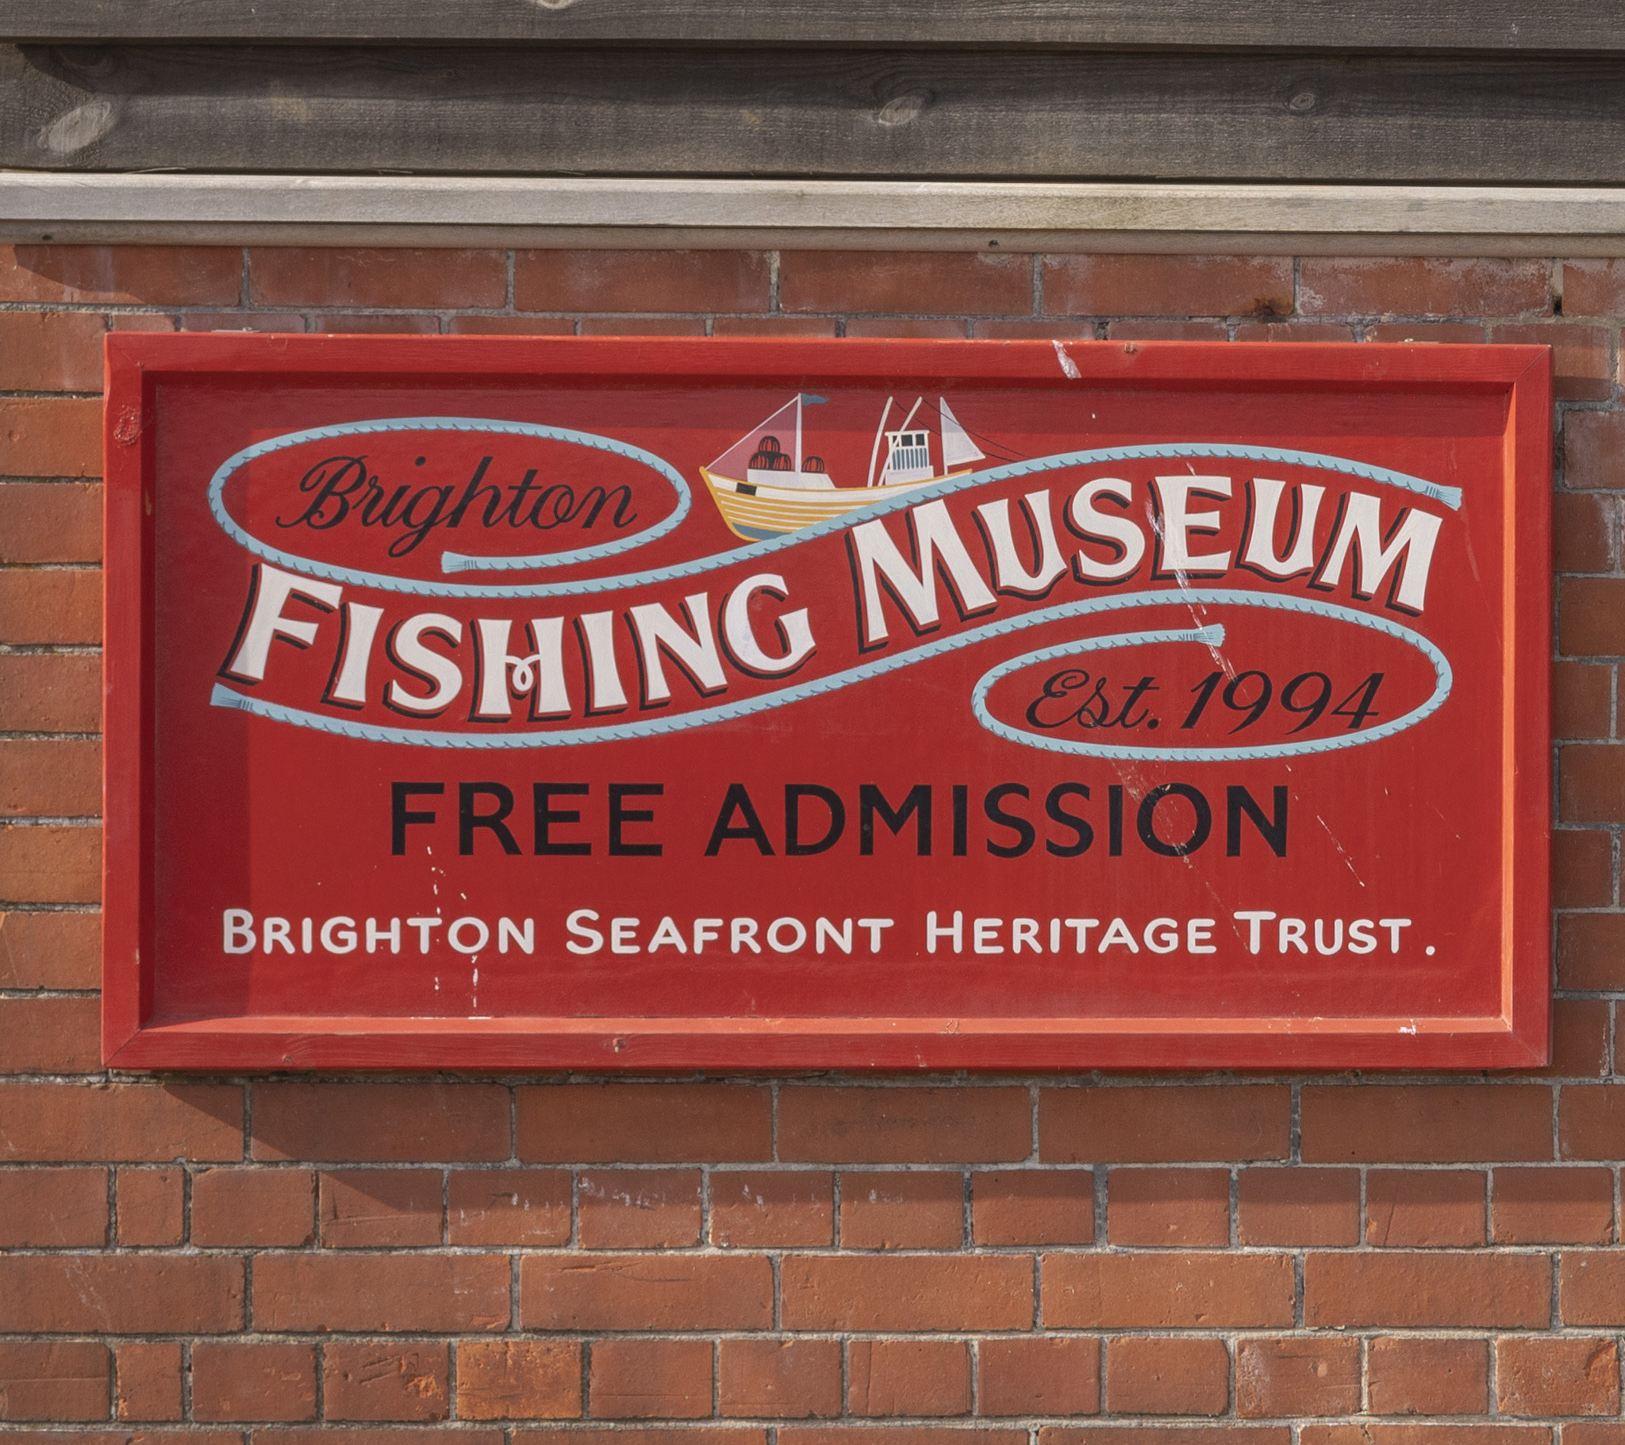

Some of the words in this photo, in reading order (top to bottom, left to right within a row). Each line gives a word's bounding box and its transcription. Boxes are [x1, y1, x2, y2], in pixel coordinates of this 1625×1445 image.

[275, 455, 637, 558] Brighton
[217, 563, 818, 723] FISHING
[845, 476, 1443, 654] MUSEUM
[1025, 669, 1160, 730] Est.
[1180, 669, 1386, 735] 1994
[391, 781, 664, 857] FREE
[704, 782, 1289, 858] ADMISSION
[222, 908, 535, 955] BRIGHTON
[565, 909, 894, 955] SEAFRONT
[925, 910, 1217, 955] HERITAGE
